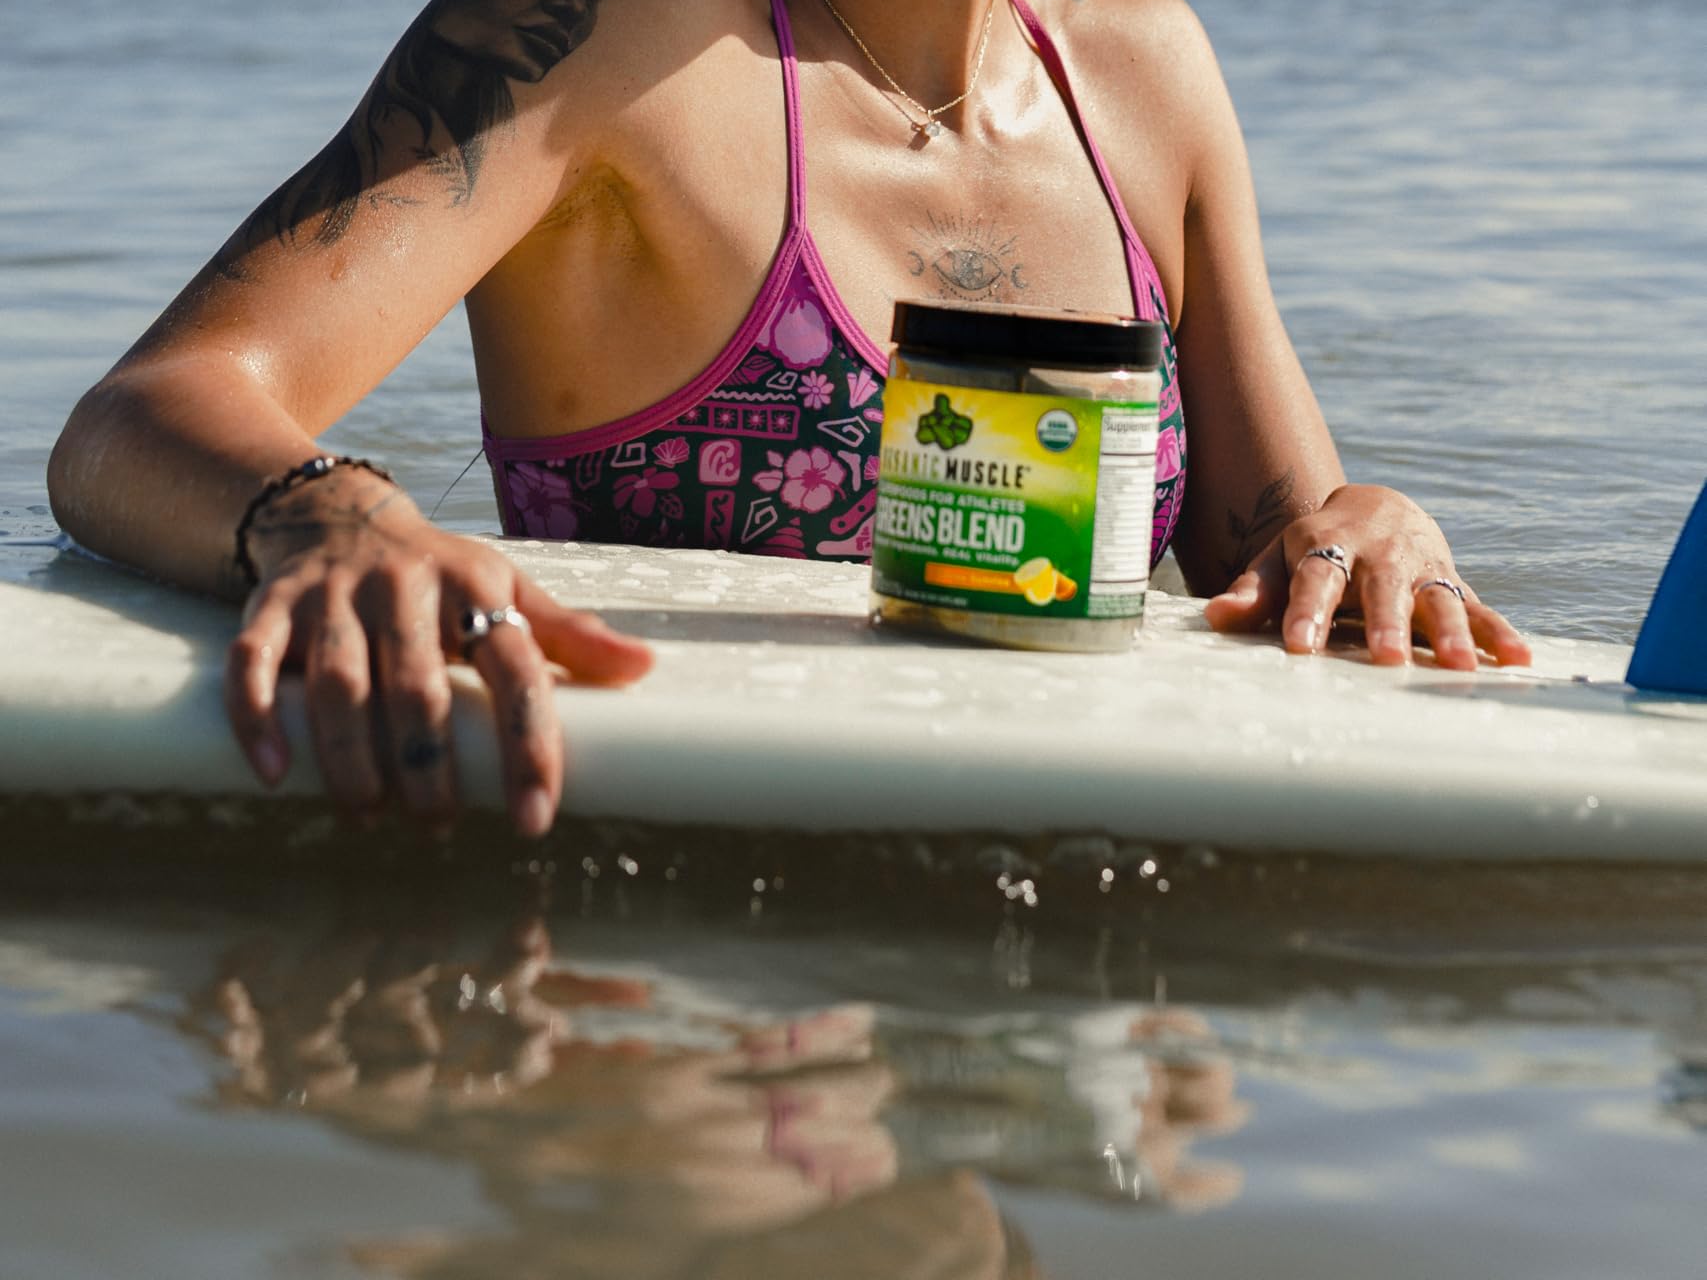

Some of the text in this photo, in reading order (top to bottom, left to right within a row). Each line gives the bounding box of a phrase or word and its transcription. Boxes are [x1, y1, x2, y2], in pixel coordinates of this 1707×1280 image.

[945, 456, 1025, 488] MUSCLE
[929, 489, 955, 505] FOR
[957, 493, 1026, 513] ATHLETES
[936, 506, 1026, 553] BLEND
